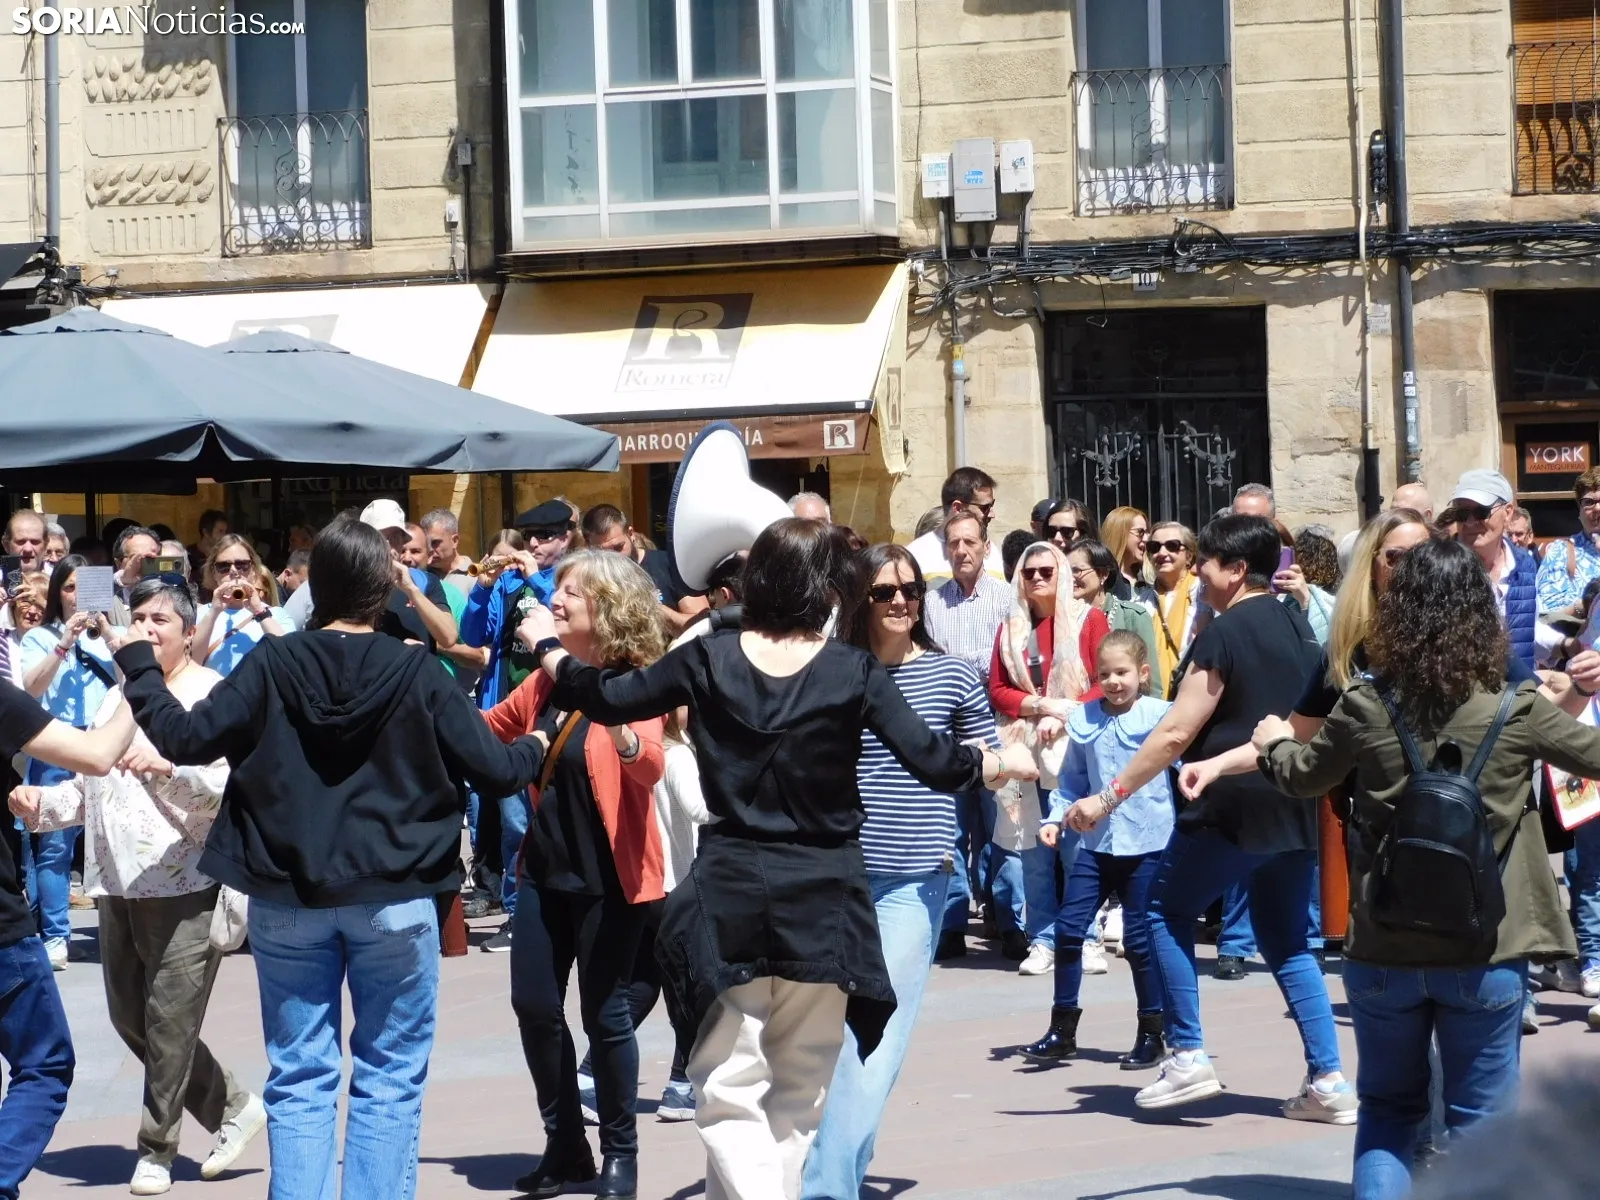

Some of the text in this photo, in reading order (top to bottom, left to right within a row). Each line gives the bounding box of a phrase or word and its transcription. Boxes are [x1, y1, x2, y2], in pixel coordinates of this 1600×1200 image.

[618, 426, 764, 451] ARROQÍA
[828, 423, 851, 447] R
[1530, 446, 1585, 463] YORK
